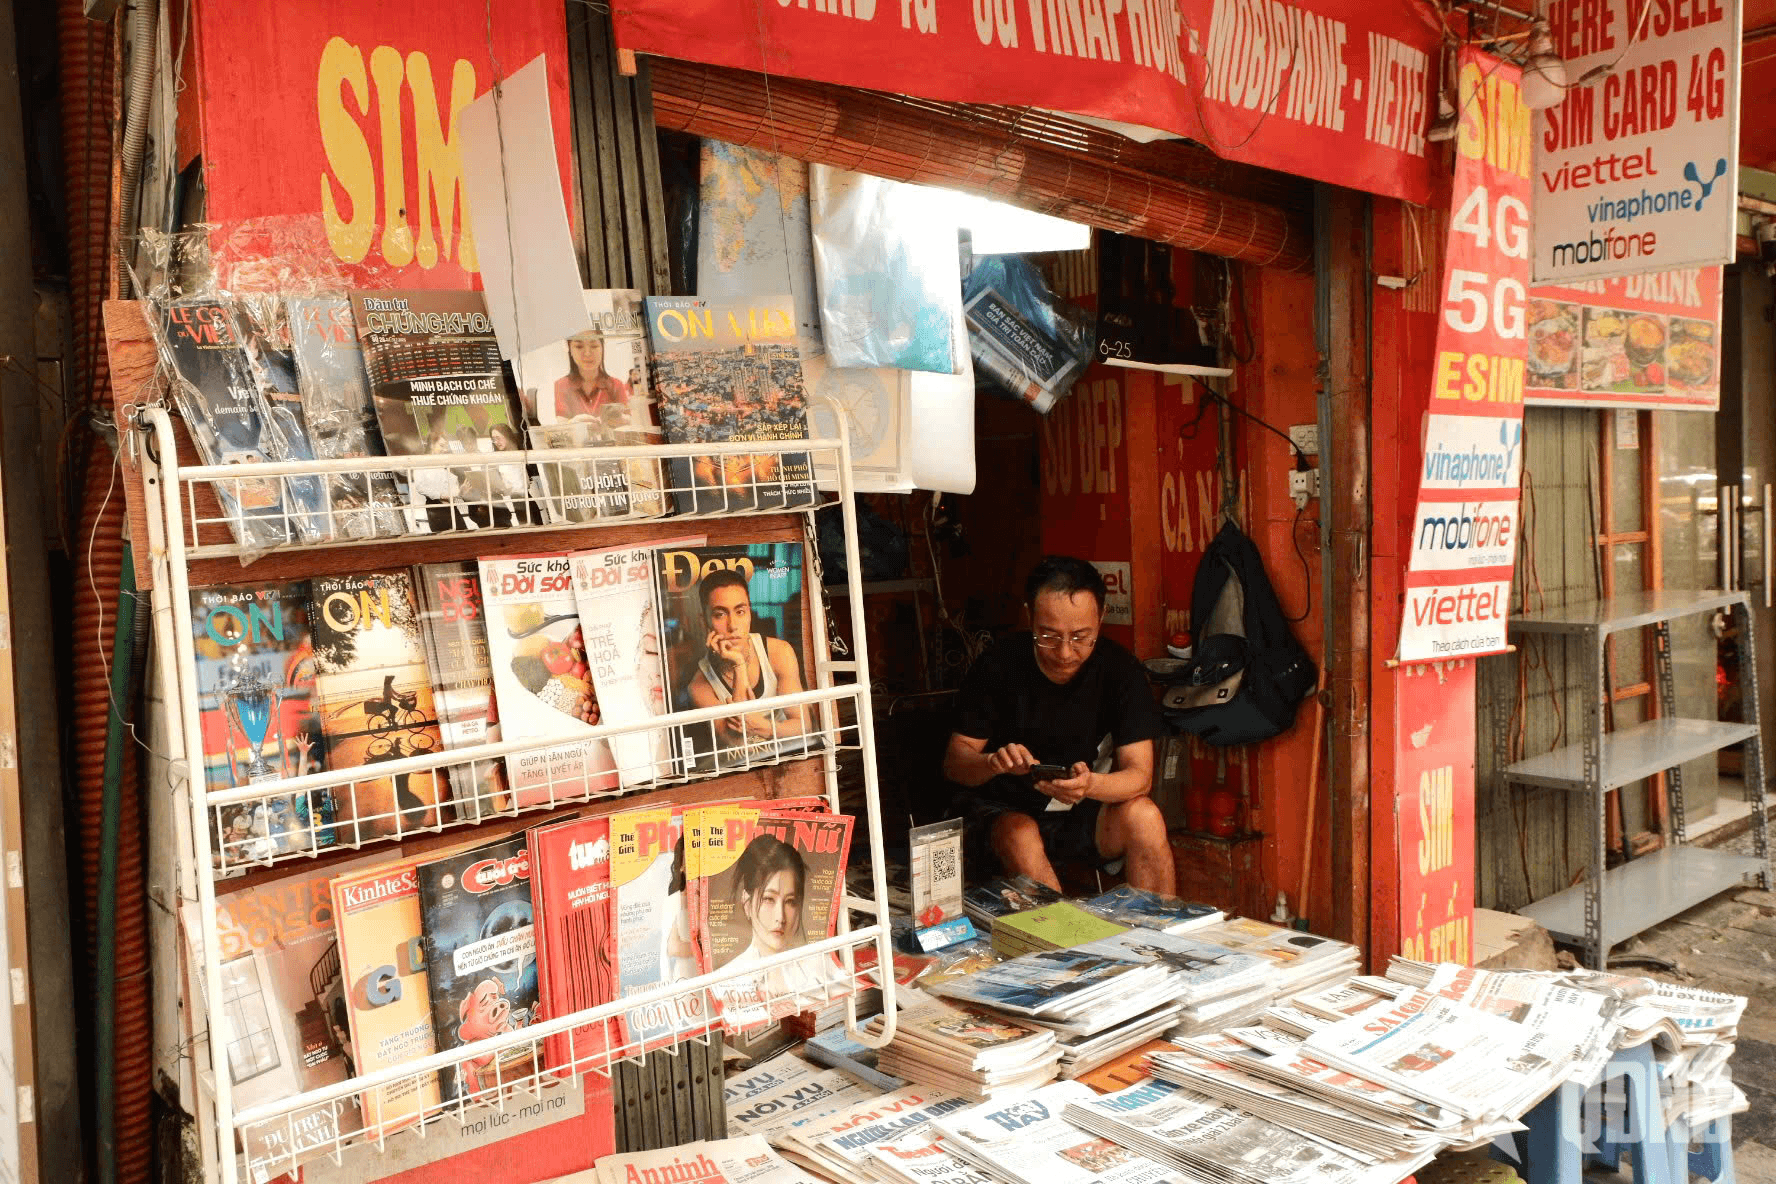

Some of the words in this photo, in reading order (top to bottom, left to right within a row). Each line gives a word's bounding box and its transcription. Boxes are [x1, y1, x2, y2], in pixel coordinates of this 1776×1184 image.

[1548, 0, 1615, 62] HERE
[1204, 0, 1348, 132] MOBIPHONE
[1544, 84, 1594, 151] SIM
[1603, 59, 1678, 142] CARD
[1687, 47, 1725, 122] 4G
[1459, 63, 1531, 179] SIM
[318, 37, 480, 271] SIM
[1542, 147, 1657, 193] viettel
[1453, 185, 1529, 259] 4G
[1587, 188, 1692, 223] vinaphone
[1552, 227, 1657, 268] mobifone
[1445, 269, 1526, 339] 5G
[657, 309, 714, 342] ON
[1100, 339, 1132, 358] 6-25
[410, 380, 436, 393] MINH
[437, 380, 463, 394] BẠCH
[478, 376, 496, 391] CHẾ
[1436, 351, 1525, 404] ESIM
[411, 392, 436, 407] THUẾ
[437, 391, 468, 406] CHỨNG
[470, 391, 502, 405] KHOÁN
[756, 422, 772, 433] SẮP
[773, 421, 790, 433] XẾP
[790, 421, 802, 433] LẠI
[777, 430, 803, 442] CHÍNH
[1425, 443, 1502, 487] vinaphone
[580, 492, 607, 508] ROOM
[1419, 503, 1511, 551] mobifone
[517, 560, 542, 575] Sức
[591, 566, 621, 590] Đời
[604, 551, 627, 567] Sức
[202, 594, 228, 605] THỜI
[232, 591, 253, 603] BÁO
[320, 580, 342, 593] THỜI
[345, 579, 364, 591] BÁO
[501, 576, 535, 596] Đời
[1413, 585, 1500, 627] viettel
[205, 600, 285, 646] ON
[322, 588, 393, 633] ON
[521, 766, 545, 781] TĂNG
[1419, 765, 1453, 876] SIM
[461, 1120, 488, 1144] mọi
[489, 1111, 509, 1131] lúc
[520, 1103, 544, 1125] mọi
[545, 1092, 567, 1113] nơi
